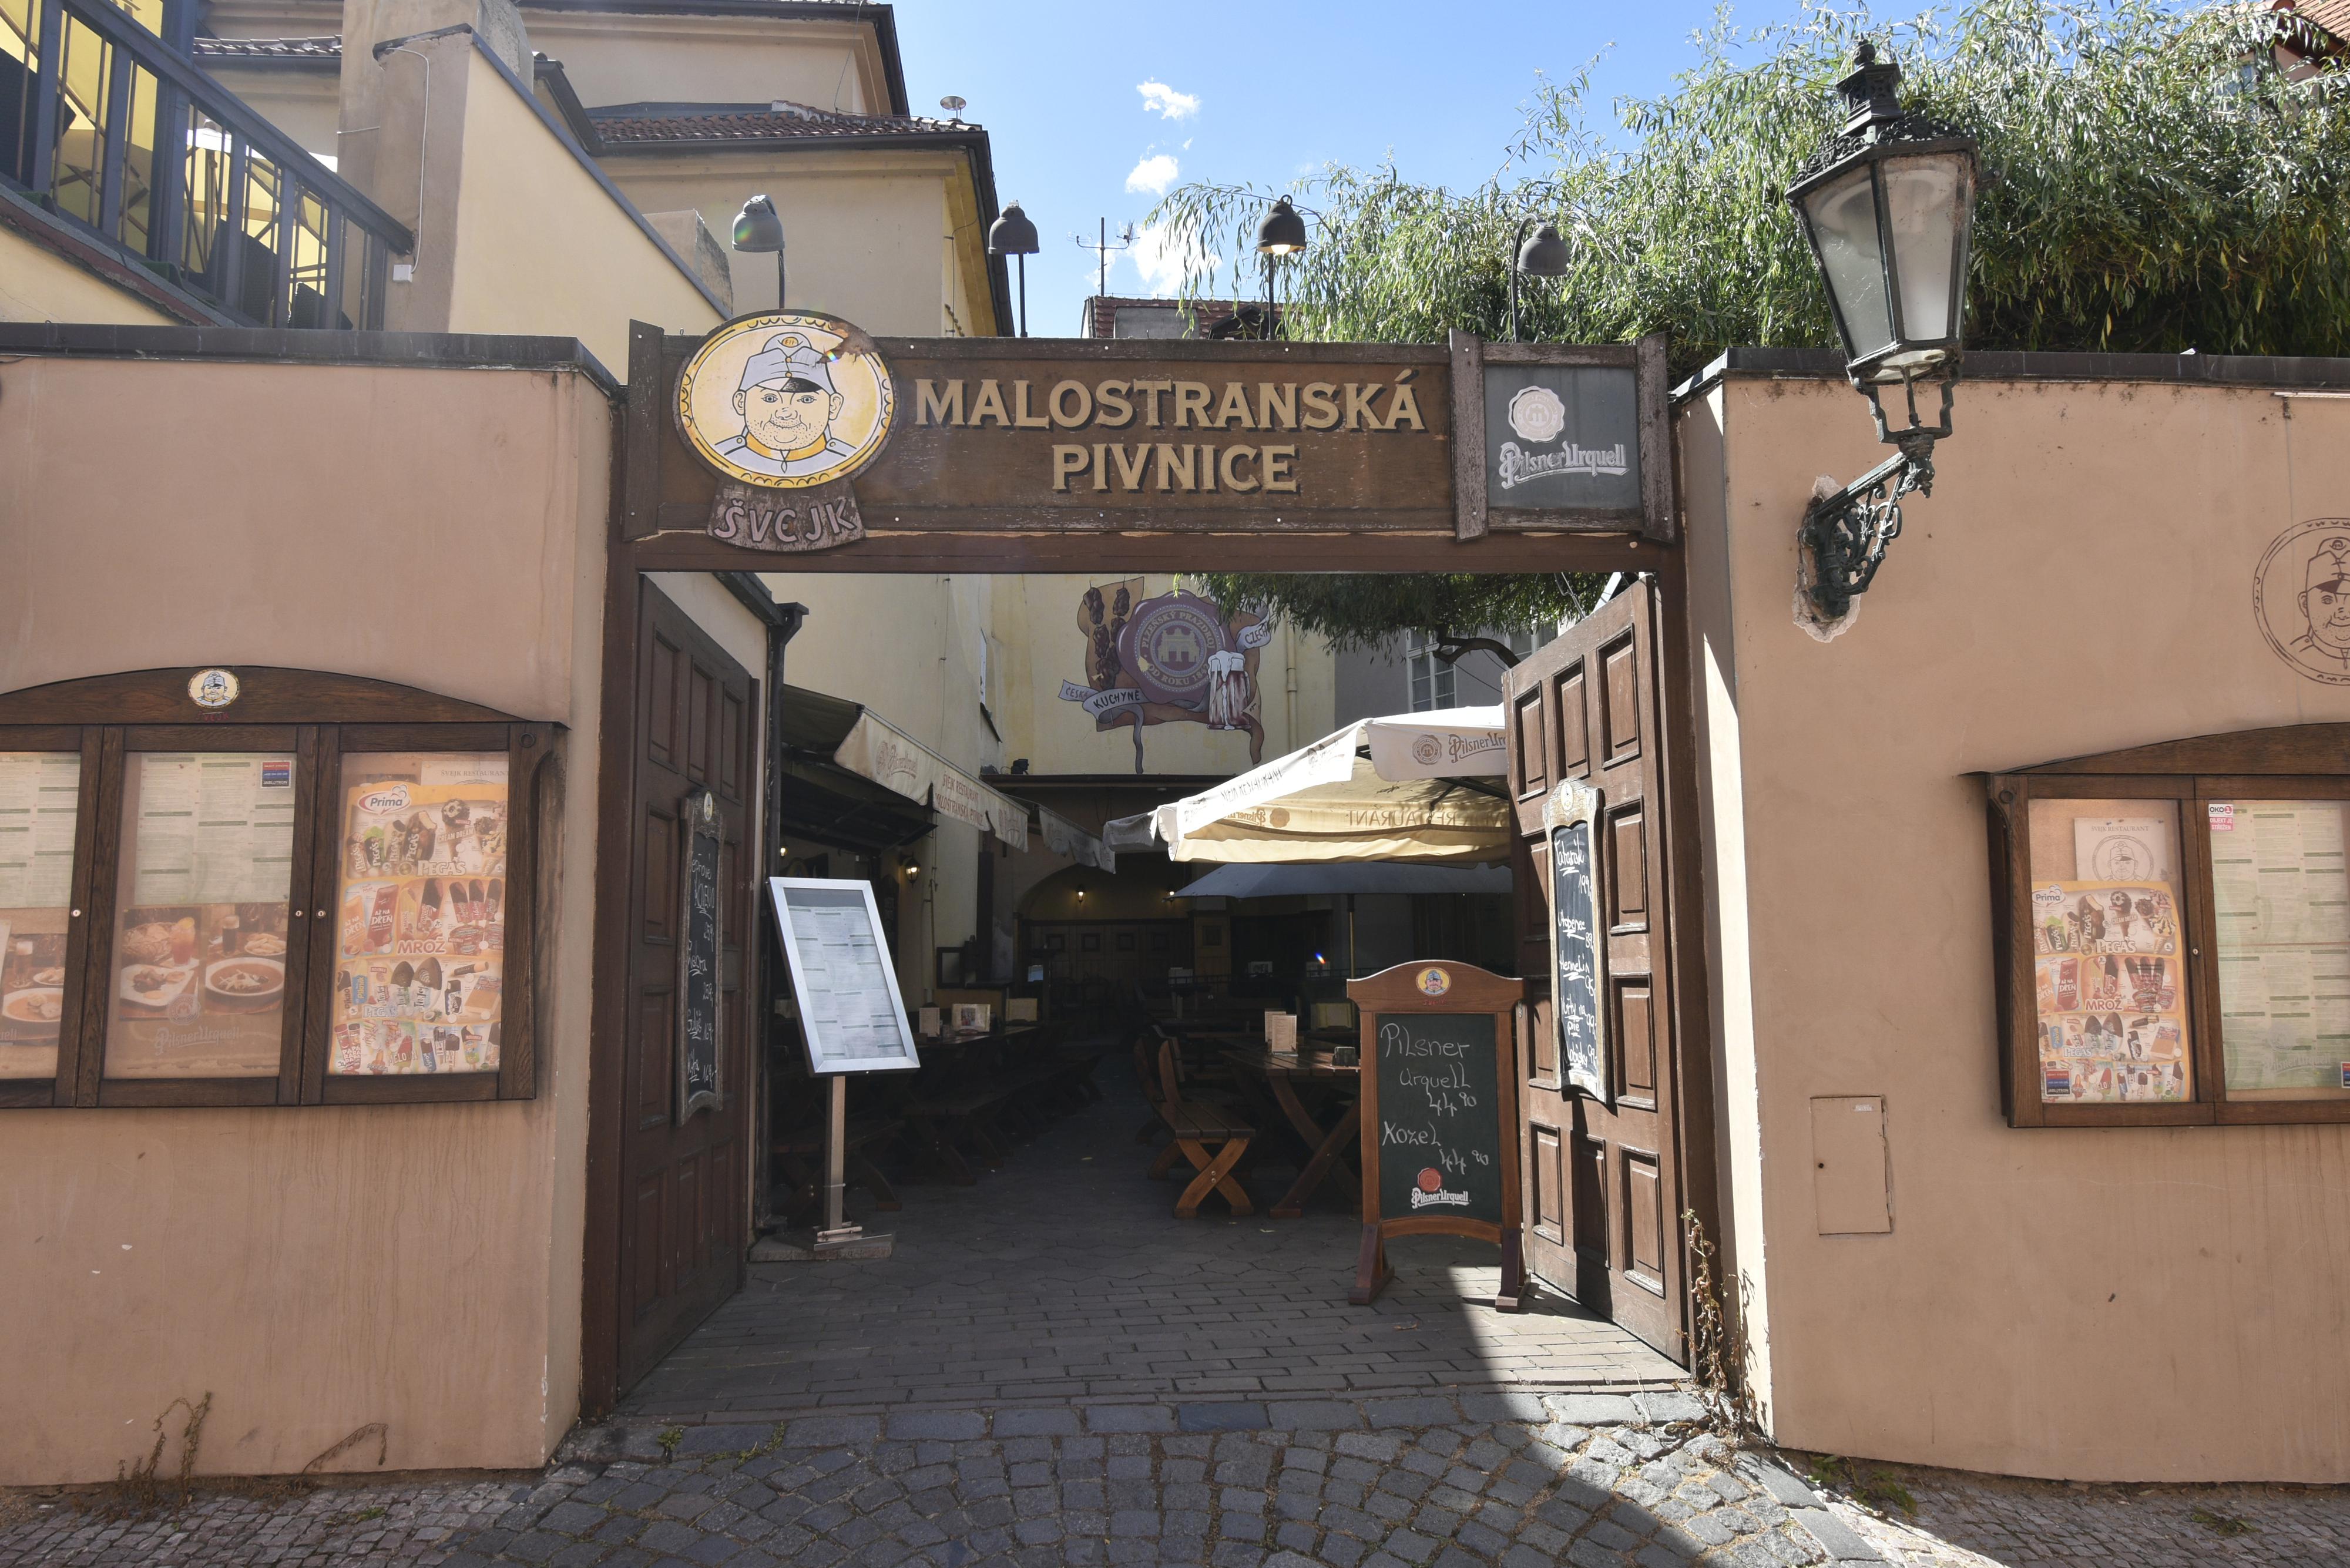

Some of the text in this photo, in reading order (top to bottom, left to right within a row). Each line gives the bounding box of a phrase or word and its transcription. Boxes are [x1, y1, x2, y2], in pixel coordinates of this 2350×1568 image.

[915, 368, 1426, 430] MALOSTRANSKÁ
[1052, 442, 1297, 493] PIVNICE
[1499, 441, 1627, 489] Pilsner Urquell
[713, 498, 857, 543] ŠVEJK
[1245, 622, 1268, 645] CZECH
[1161, 675, 1190, 686] ROKU
[1093, 690, 1141, 709] KUCHYNĚ
[1448, 734, 1489, 764] Pilsner
[370, 797, 403, 807] Prima
[397, 936, 445, 955] MROŽ
[2086, 996, 2123, 1010] MROŽ
[155, 1027, 199, 1056] Pilsner
[1381, 1023, 1471, 1057] Pilsner
[1382, 1120, 1442, 1146] Kozel
[1411, 1187, 1469, 1209] Pilsner Urquell
